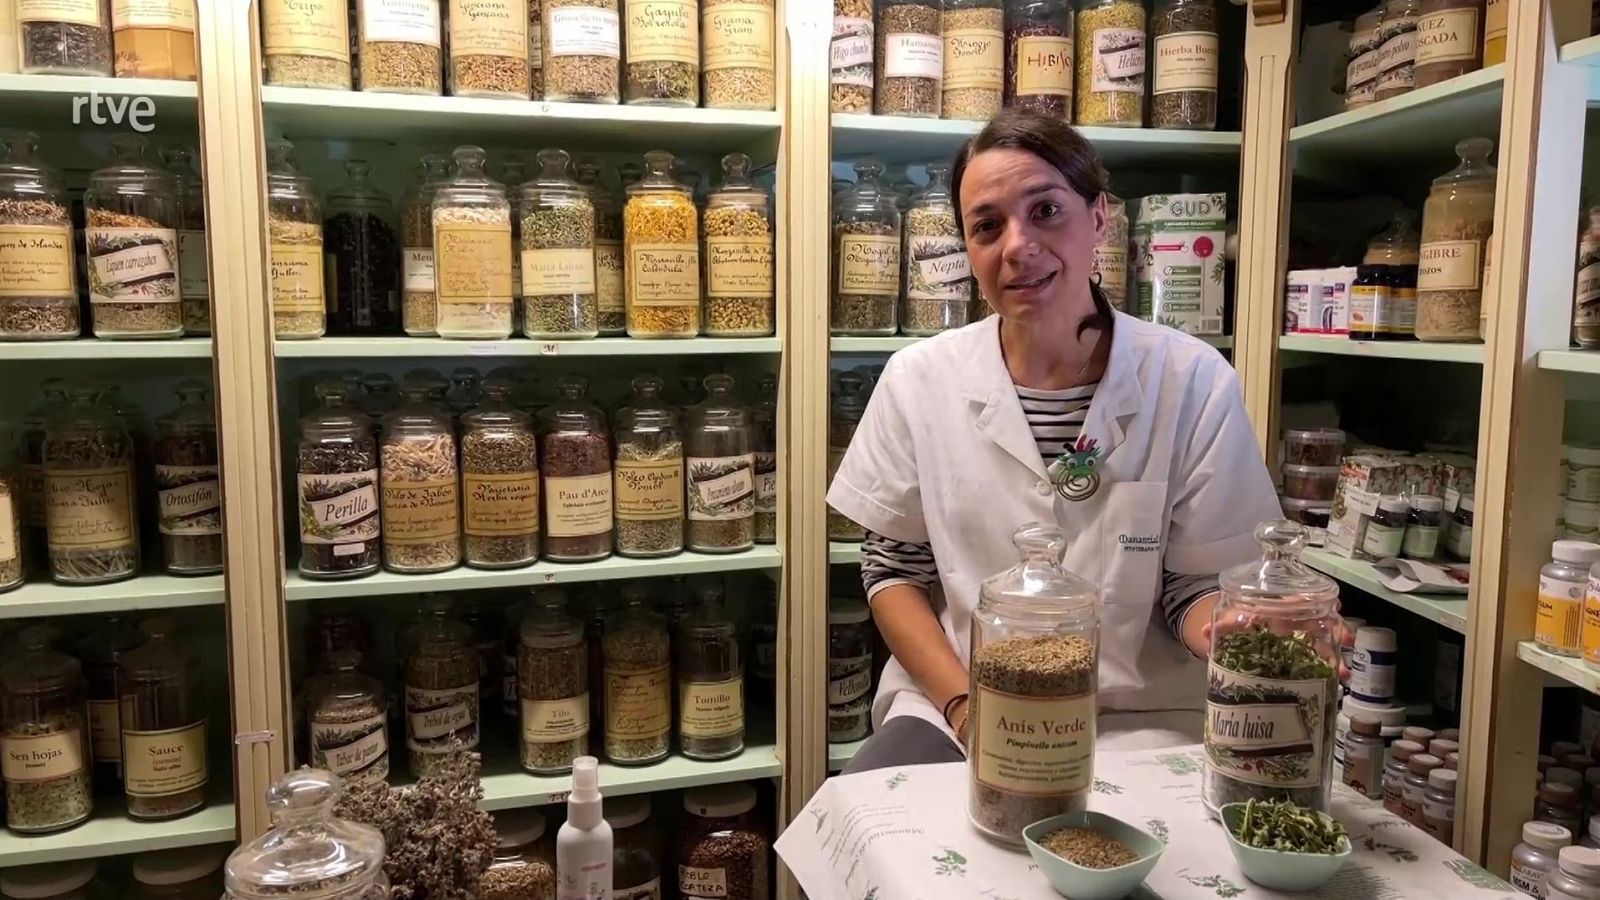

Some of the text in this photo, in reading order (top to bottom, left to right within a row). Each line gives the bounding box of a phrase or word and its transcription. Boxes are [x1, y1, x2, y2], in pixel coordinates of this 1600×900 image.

[1160, 47, 1193, 57] Hierba
[1171, 201, 1211, 217] GUD
[929, 259, 970, 276] Nepta
[167, 488, 212, 508] Ortosifón
[559, 491, 578, 500] Pau
[324, 498, 369, 522] Perilla
[693, 694, 730, 704] Tomillo
[1042, 718, 1086, 735] Verde
[1242, 713, 1275, 739] luisa
[149, 745, 184, 757] Sauce
[1006, 738, 1050, 750] Pimpinella
[10, 748, 63, 761] Sen hojas
